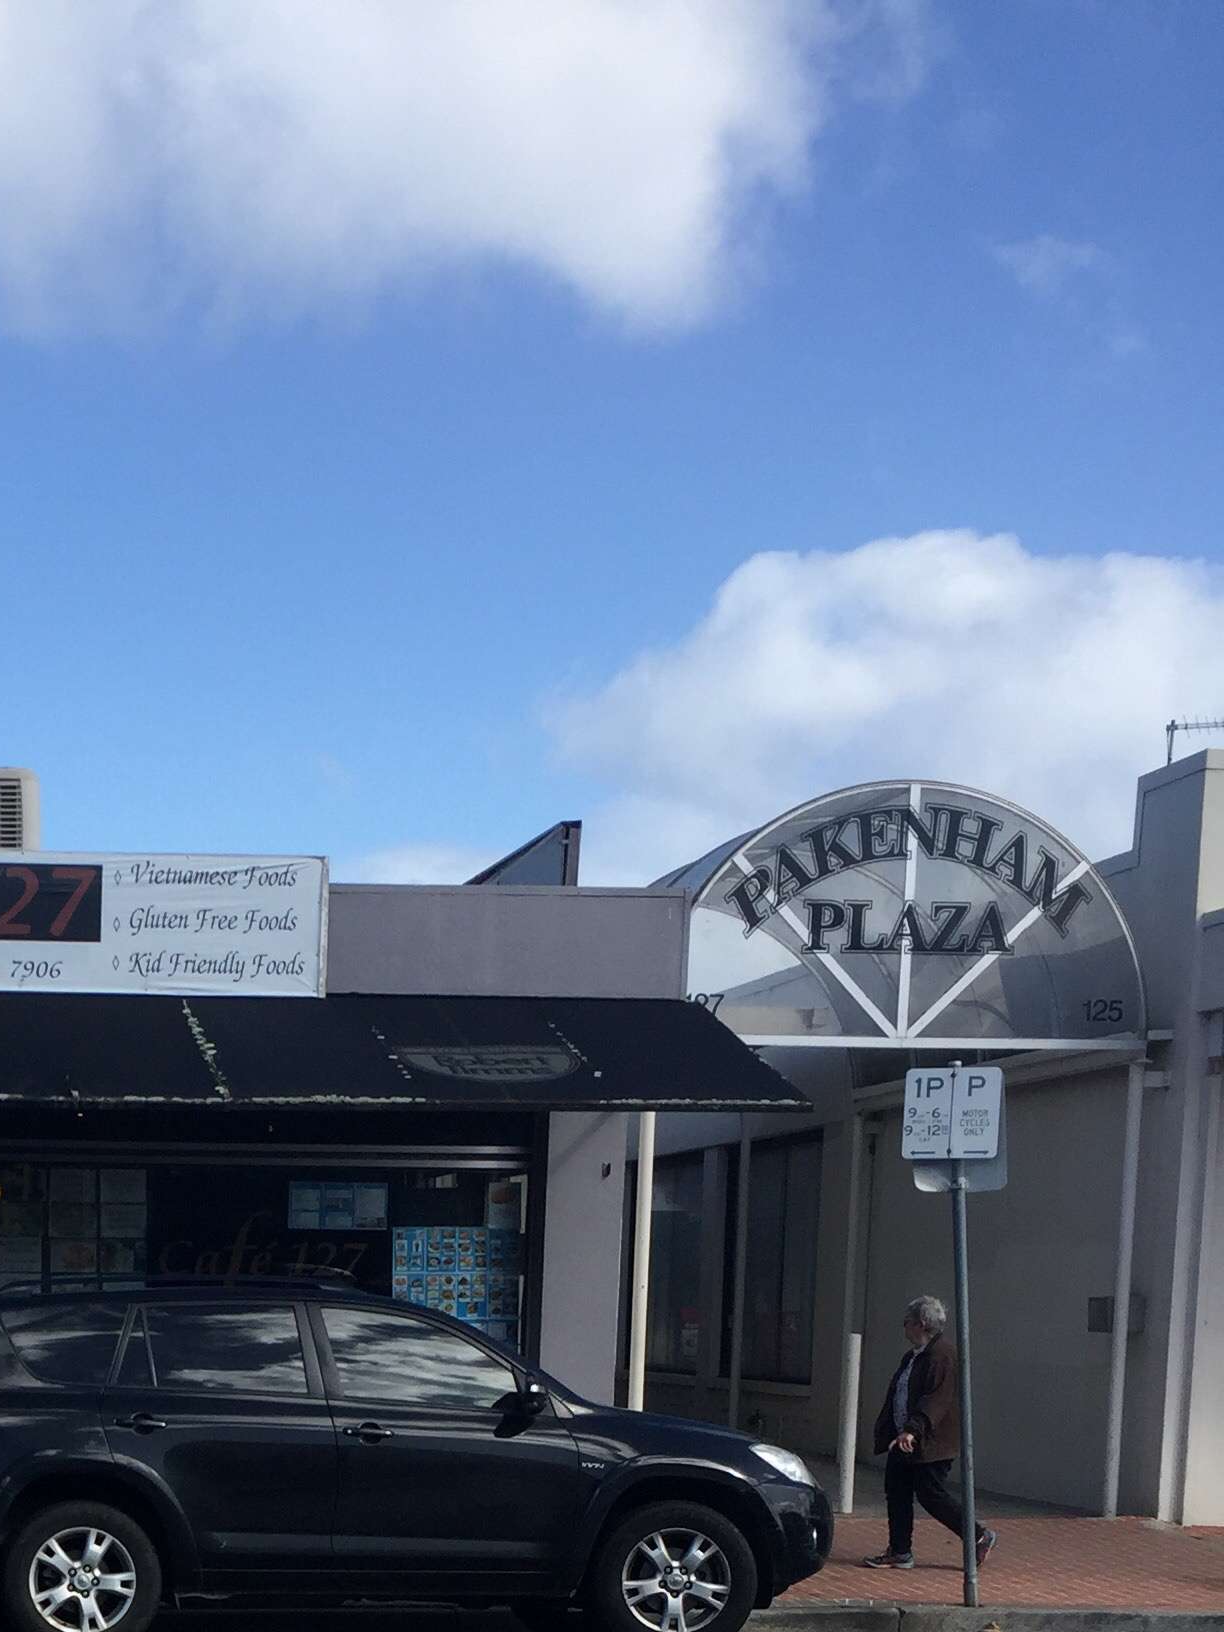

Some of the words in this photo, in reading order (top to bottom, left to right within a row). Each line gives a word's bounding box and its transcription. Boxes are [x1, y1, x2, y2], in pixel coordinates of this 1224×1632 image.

[130, 861, 238, 886] Vietnamese
[242, 863, 298, 889] Foods
[725, 802, 1093, 939] PAKENHAM
[129, 905, 190, 936] Gluten
[194, 908, 238, 933] Free
[242, 907, 298, 934] Foods
[801, 899, 1015, 955] PLAZA
[10, 960, 62, 981] 7906
[129, 950, 167, 977] Kid
[168, 951, 246, 982] Friendly
[250, 952, 305, 978] Foods
[1082, 1000, 1124, 1023] 125
[915, 1077, 944, 1098] 1P
[967, 1076, 986, 1097] P
[959, 1119, 990, 1127] CYCLES
[961, 1109, 989, 1118] MOTOR
[963, 1128, 985, 1136] ONLY
